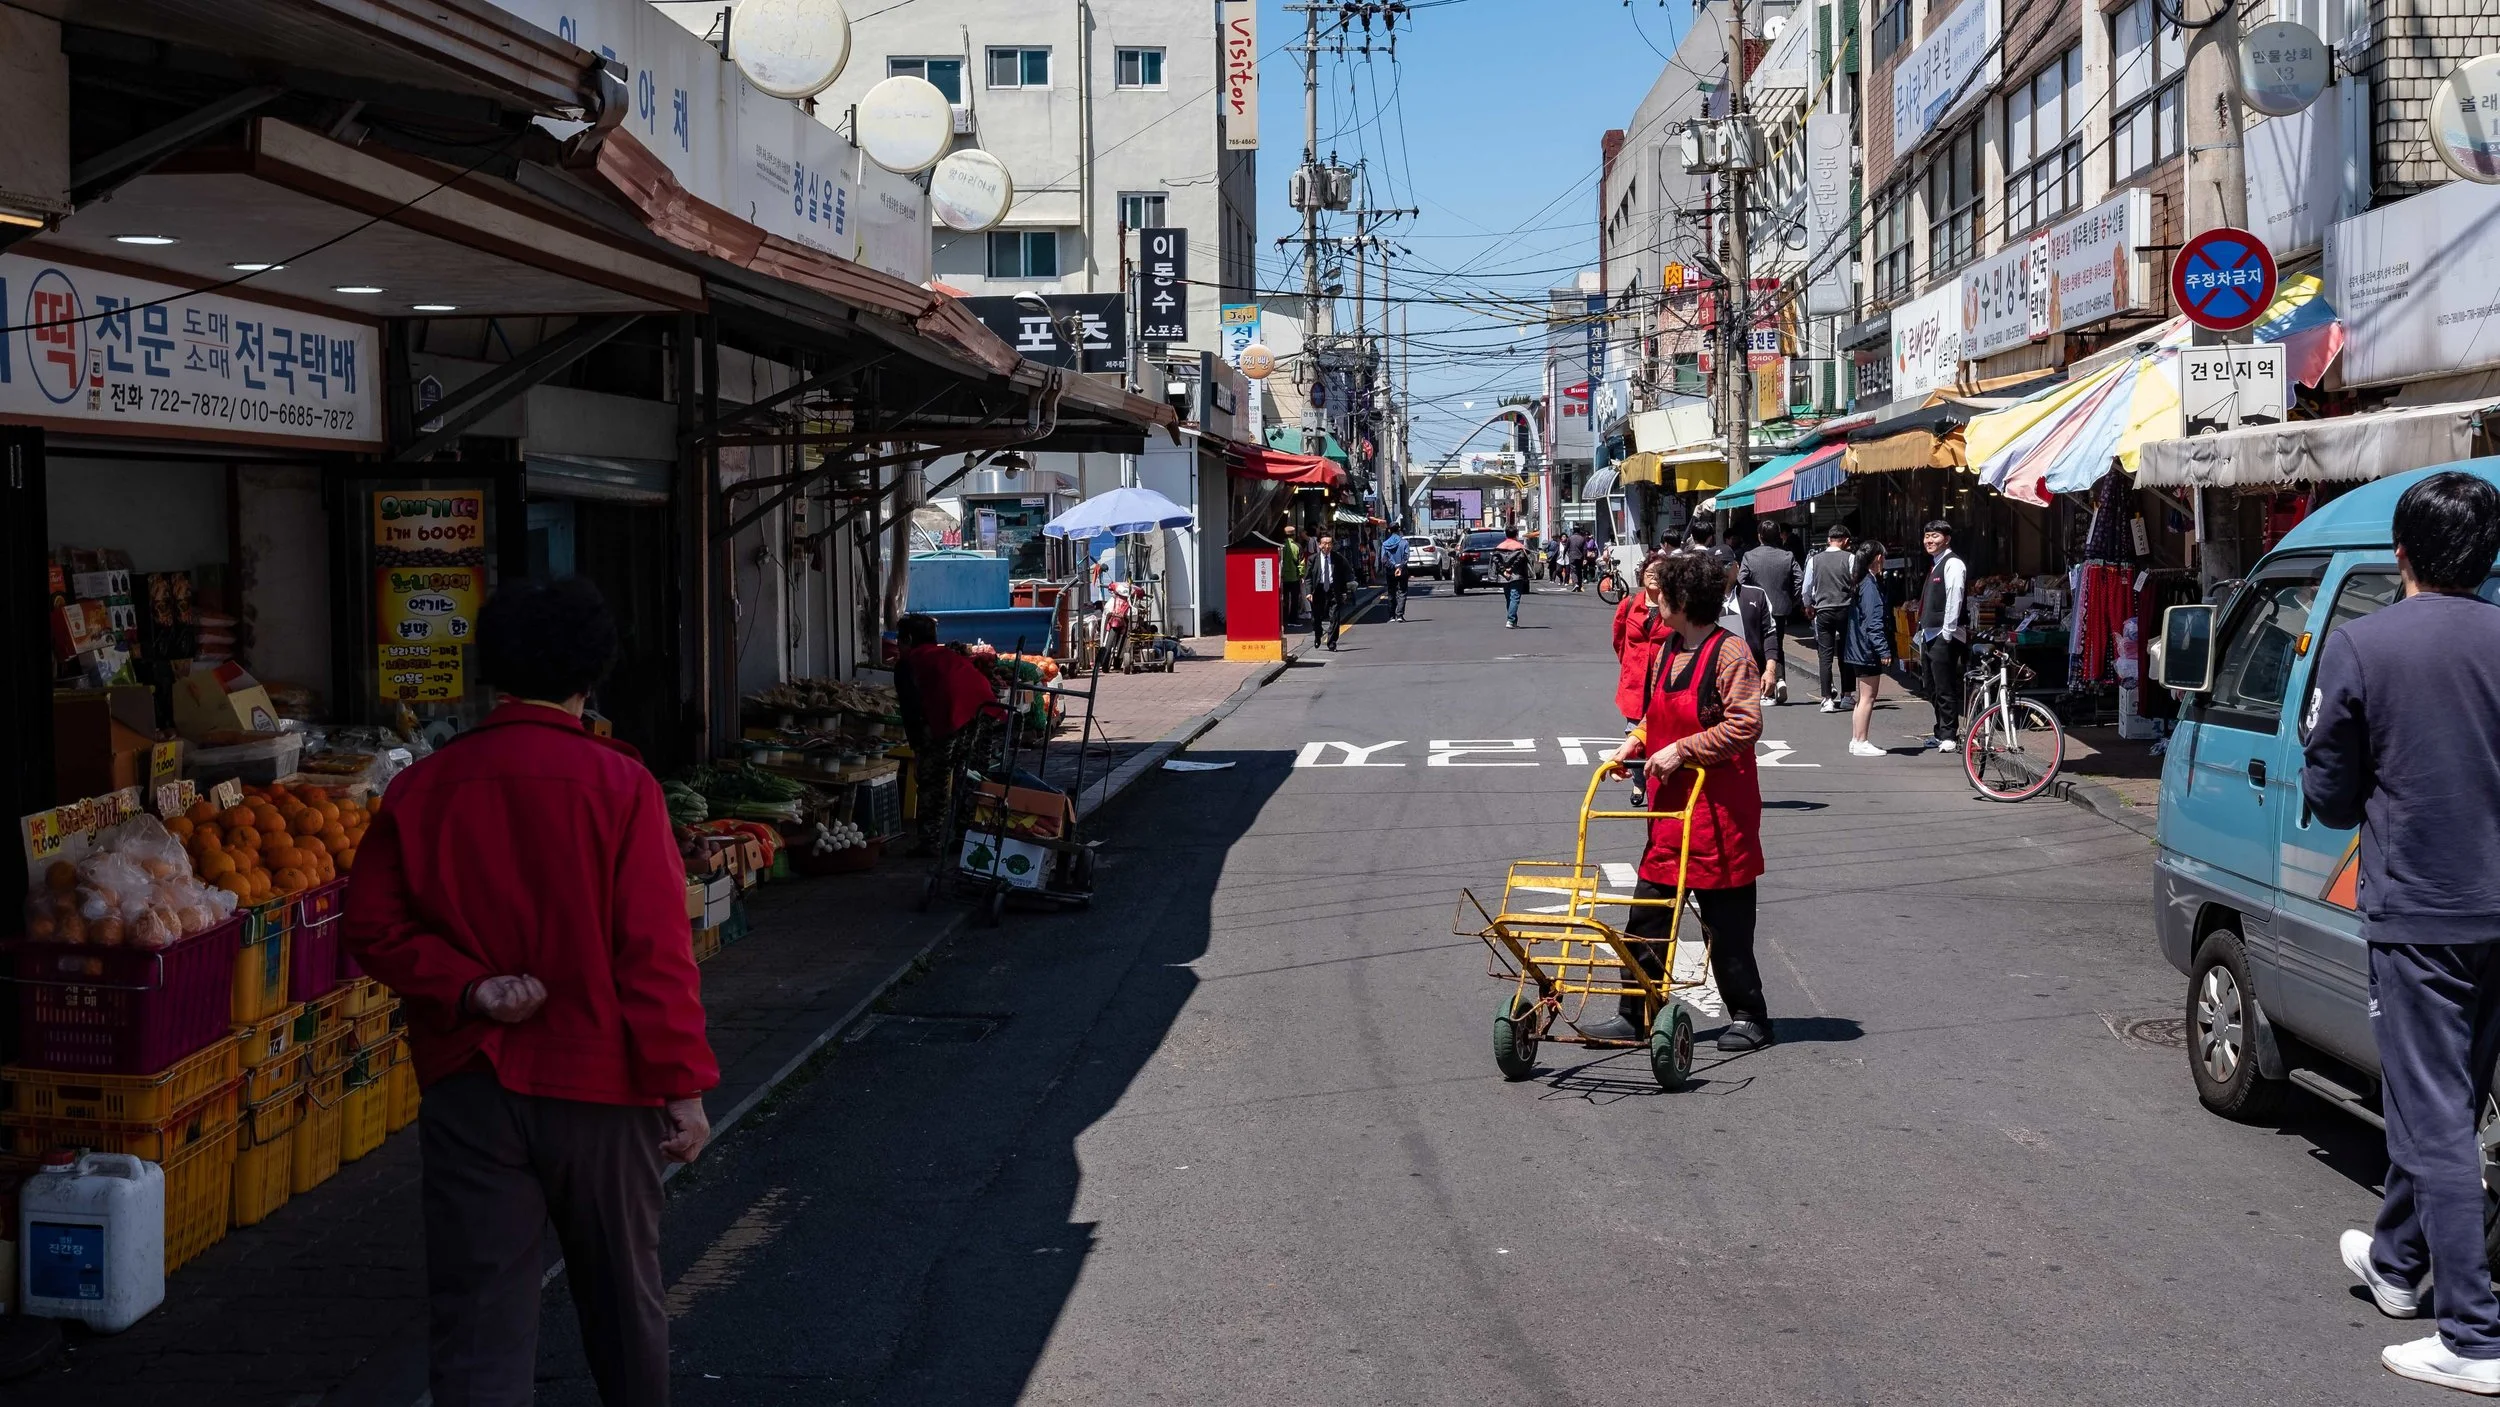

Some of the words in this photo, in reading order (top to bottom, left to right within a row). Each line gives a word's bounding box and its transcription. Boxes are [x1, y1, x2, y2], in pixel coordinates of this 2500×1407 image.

[1229, 17, 1253, 116] Visitor
[1923, 28, 1951, 98] 피부실
[2252, 47, 2312, 64] 만물상회
[794, 160, 846, 236] 청실옥돔
[1152, 234, 1177, 315] 이동수
[2031, 244, 2048, 285] 전국
[2185, 267, 2262, 290] 주정차금지
[1981, 252, 2028, 325] 수민상회
[183, 308, 229, 344] 도매
[1230, 311, 1253, 324] Jeju
[2031, 287, 2048, 328] 택배
[34, 290, 78, 390] 떡
[95, 295, 175, 378] 전문
[978, 313, 1113, 351] 포츠
[1145, 325, 1184, 337] 스포츠
[183, 344, 230, 380] 소매
[235, 320, 356, 400] 전국택배
[1243, 354, 1271, 370] 찐빵
[1591, 327, 1602, 376] 제주은행
[2190, 359, 2275, 382] 견인지역
[110, 383, 144, 413] 전화
[240, 401, 355, 431] 010-6685-7872
[380, 496, 479, 521] 오메기떡
[386, 525, 411, 541] 1개
[417, 524, 476, 542] 600원
[391, 573, 471, 593] 노니원액
[393, 672, 424, 685] 아몬드
[48, 1242, 85, 1256] 진간장
